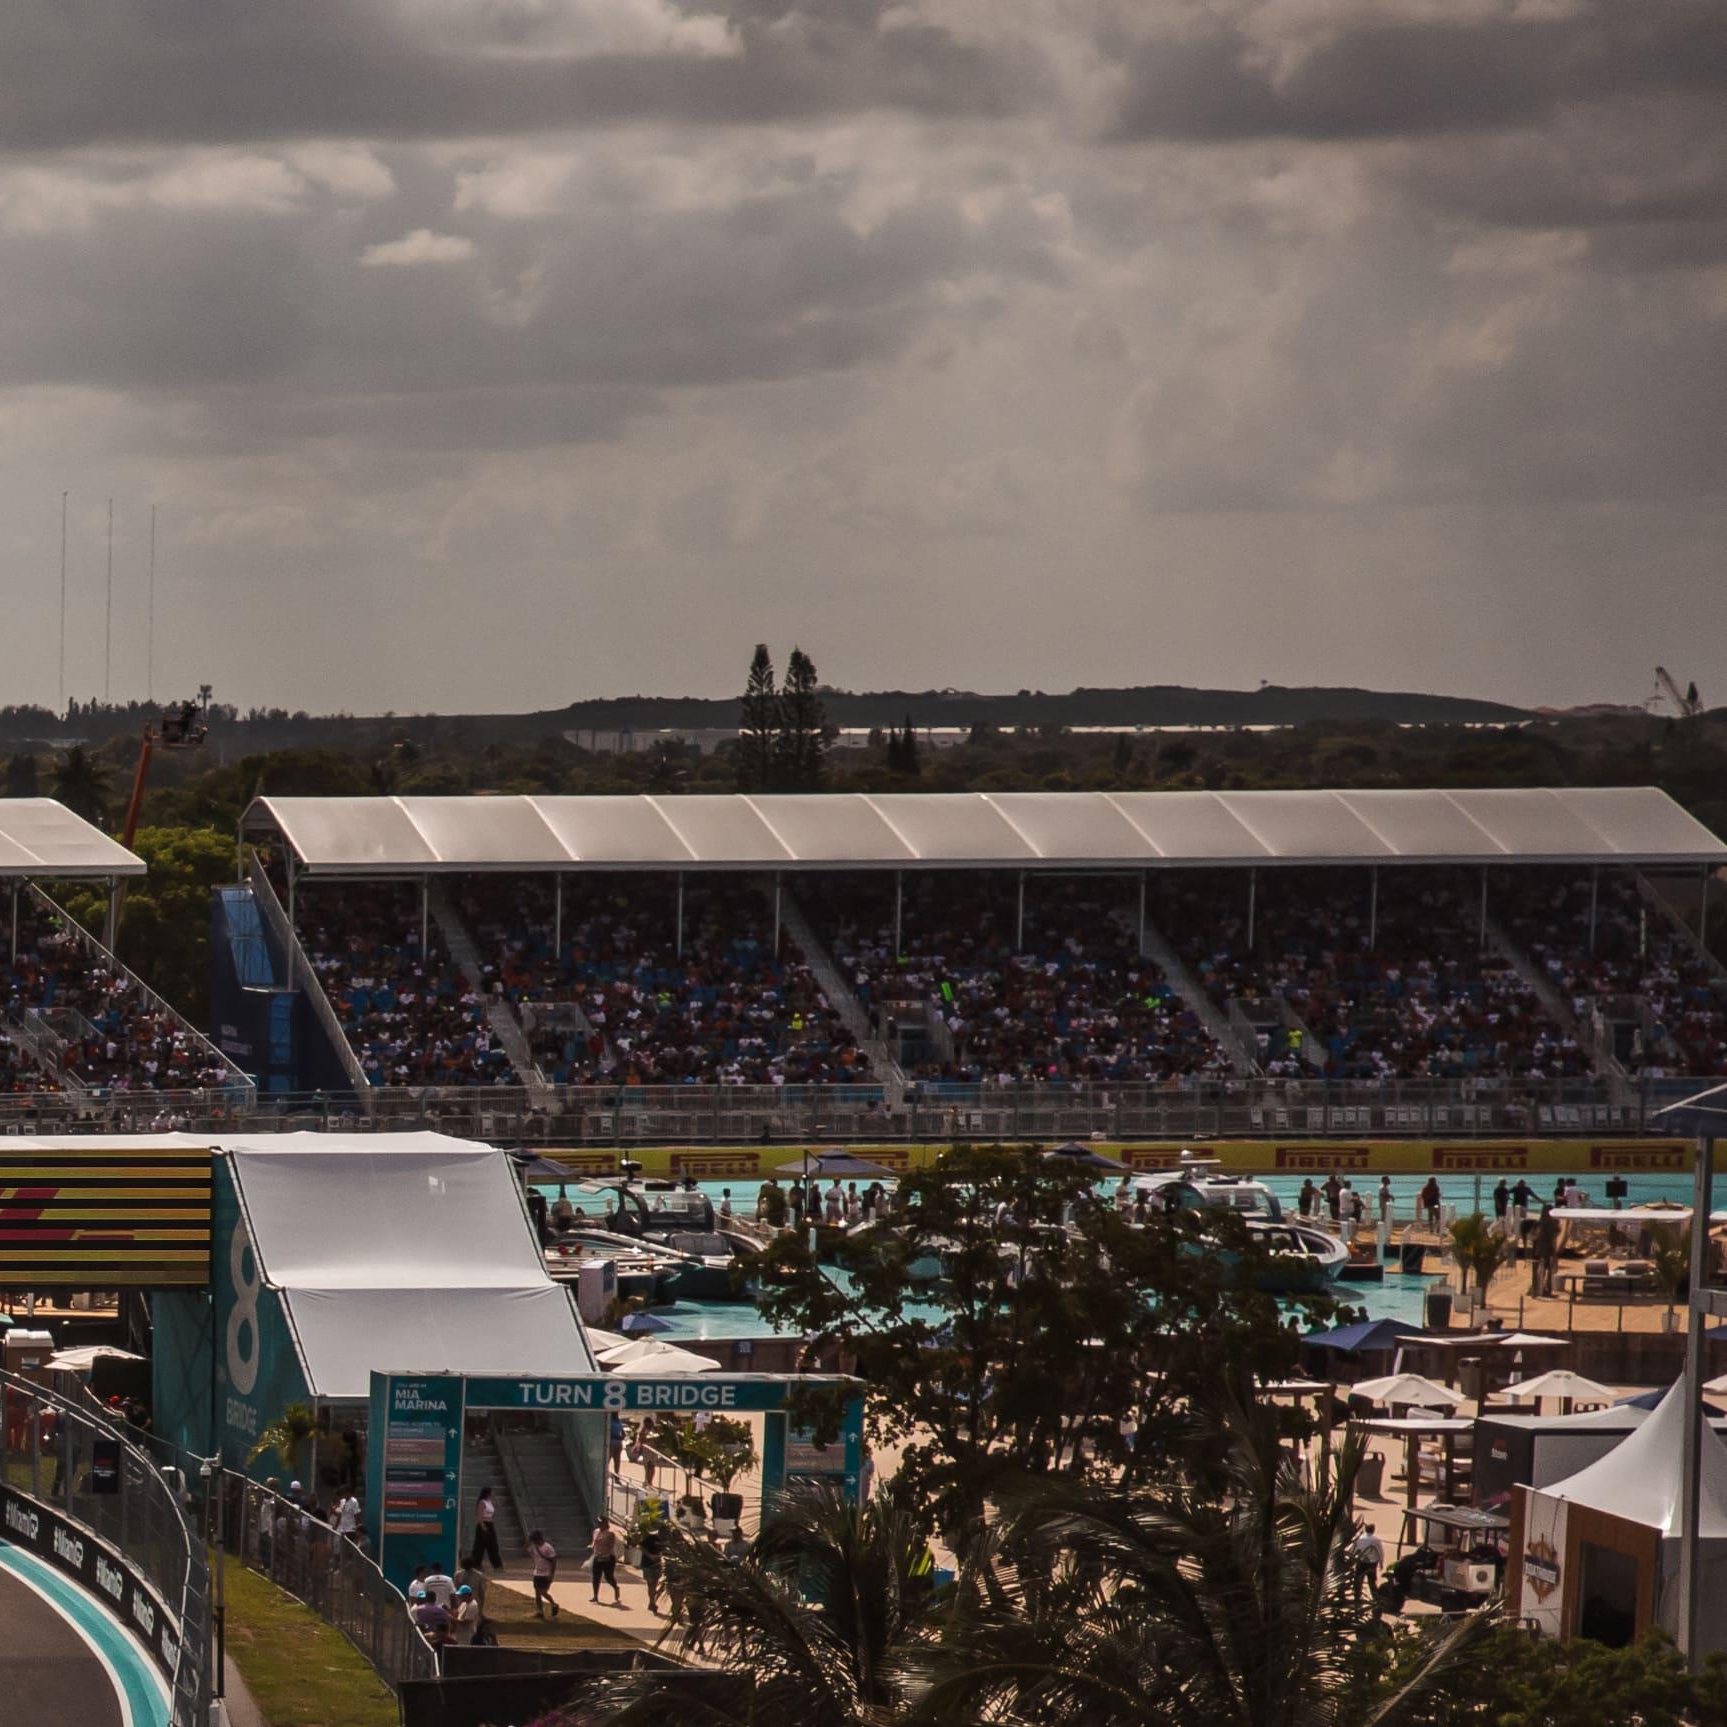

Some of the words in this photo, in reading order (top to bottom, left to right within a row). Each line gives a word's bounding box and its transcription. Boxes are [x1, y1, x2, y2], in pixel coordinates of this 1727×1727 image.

[1276, 1147, 1369, 1168] PIRELLI
[1433, 1148, 1527, 1169] PIRELLI
[1591, 1146, 1685, 1168] PIRELLI
[227, 1213, 260, 1395] 8
[394, 1400, 448, 1410] MARINA
[395, 1389, 419, 1399] MIA
[519, 1383, 592, 1404] TURN
[603, 1380, 627, 1410] 8
[637, 1385, 736, 1406] BRIDGE
[5, 1500, 39, 1541] #MiamiGP
[53, 1526, 83, 1570] #MiamiGP
